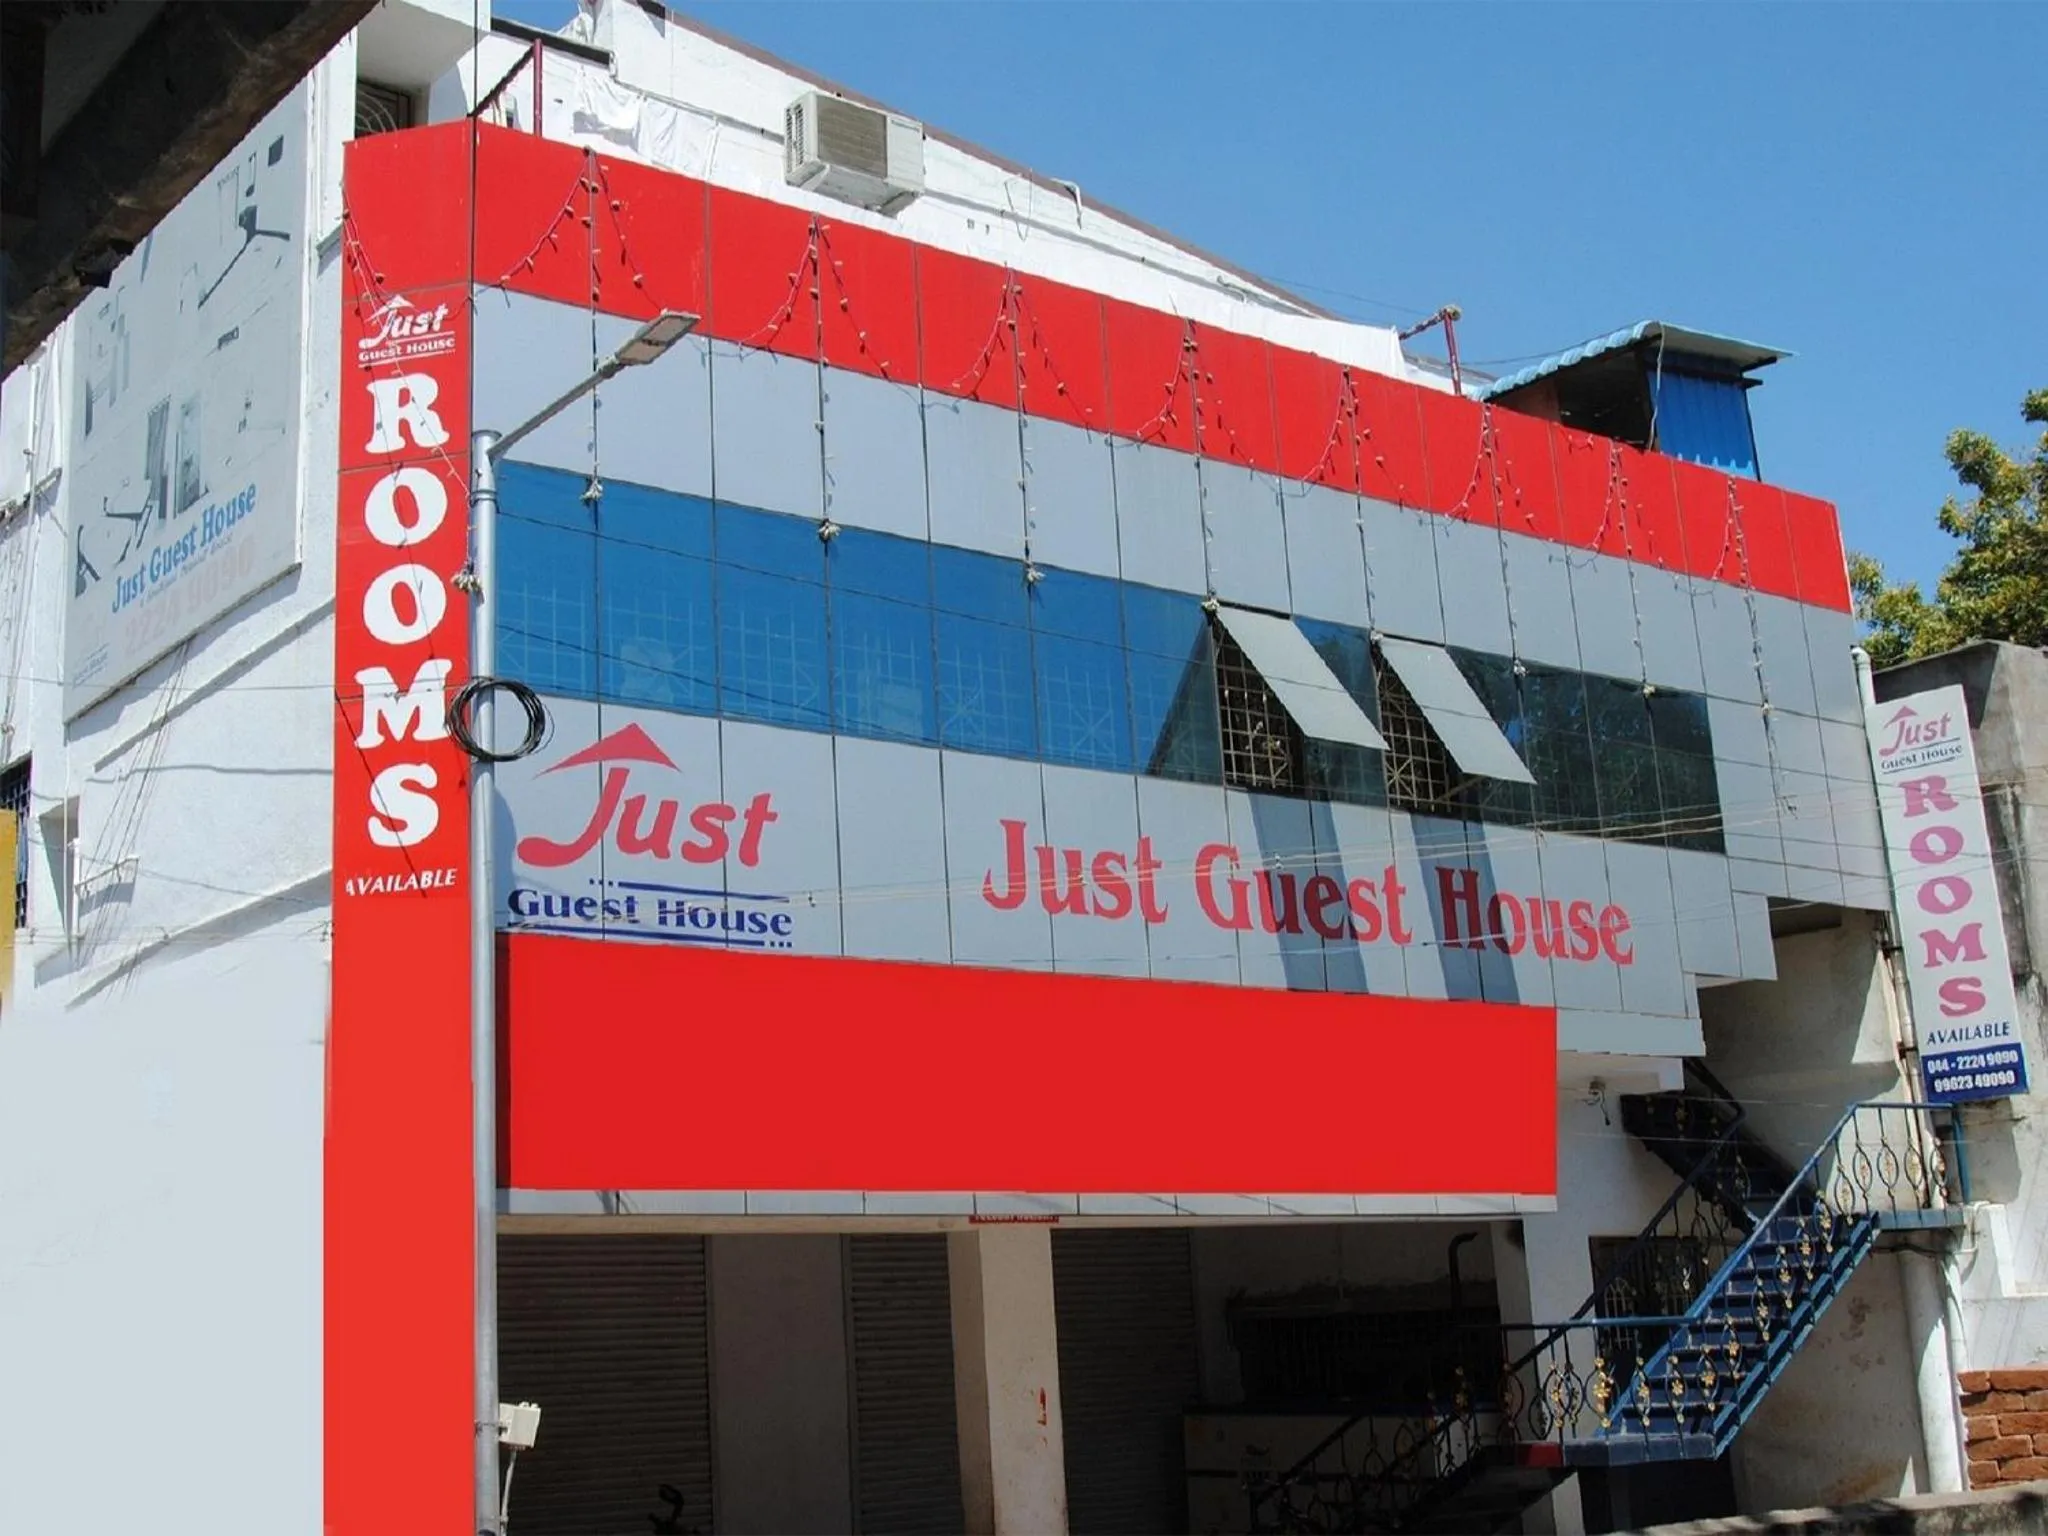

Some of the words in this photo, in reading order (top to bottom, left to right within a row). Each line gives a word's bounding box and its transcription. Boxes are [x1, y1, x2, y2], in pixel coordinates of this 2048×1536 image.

[359, 303, 449, 349] Just
[406, 338, 456, 355] House
[112, 562, 147, 614] Just
[150, 522, 198, 583] Guest
[200, 483, 257, 547] House
[353, 371, 454, 848] ROOMS
[1879, 712, 1952, 757] Just
[516, 767, 779, 868] Just
[345, 868, 458, 896] AVAILABLE
[982, 819, 1170, 925] Just
[1195, 843, 1414, 945] Guest
[1434, 866, 1635, 965] House
[1900, 774, 1988, 1018] ROOMS
[507, 888, 642, 923] Guest
[657, 898, 793, 937] House
[1927, 1021, 2010, 1045] AVAILABLE
